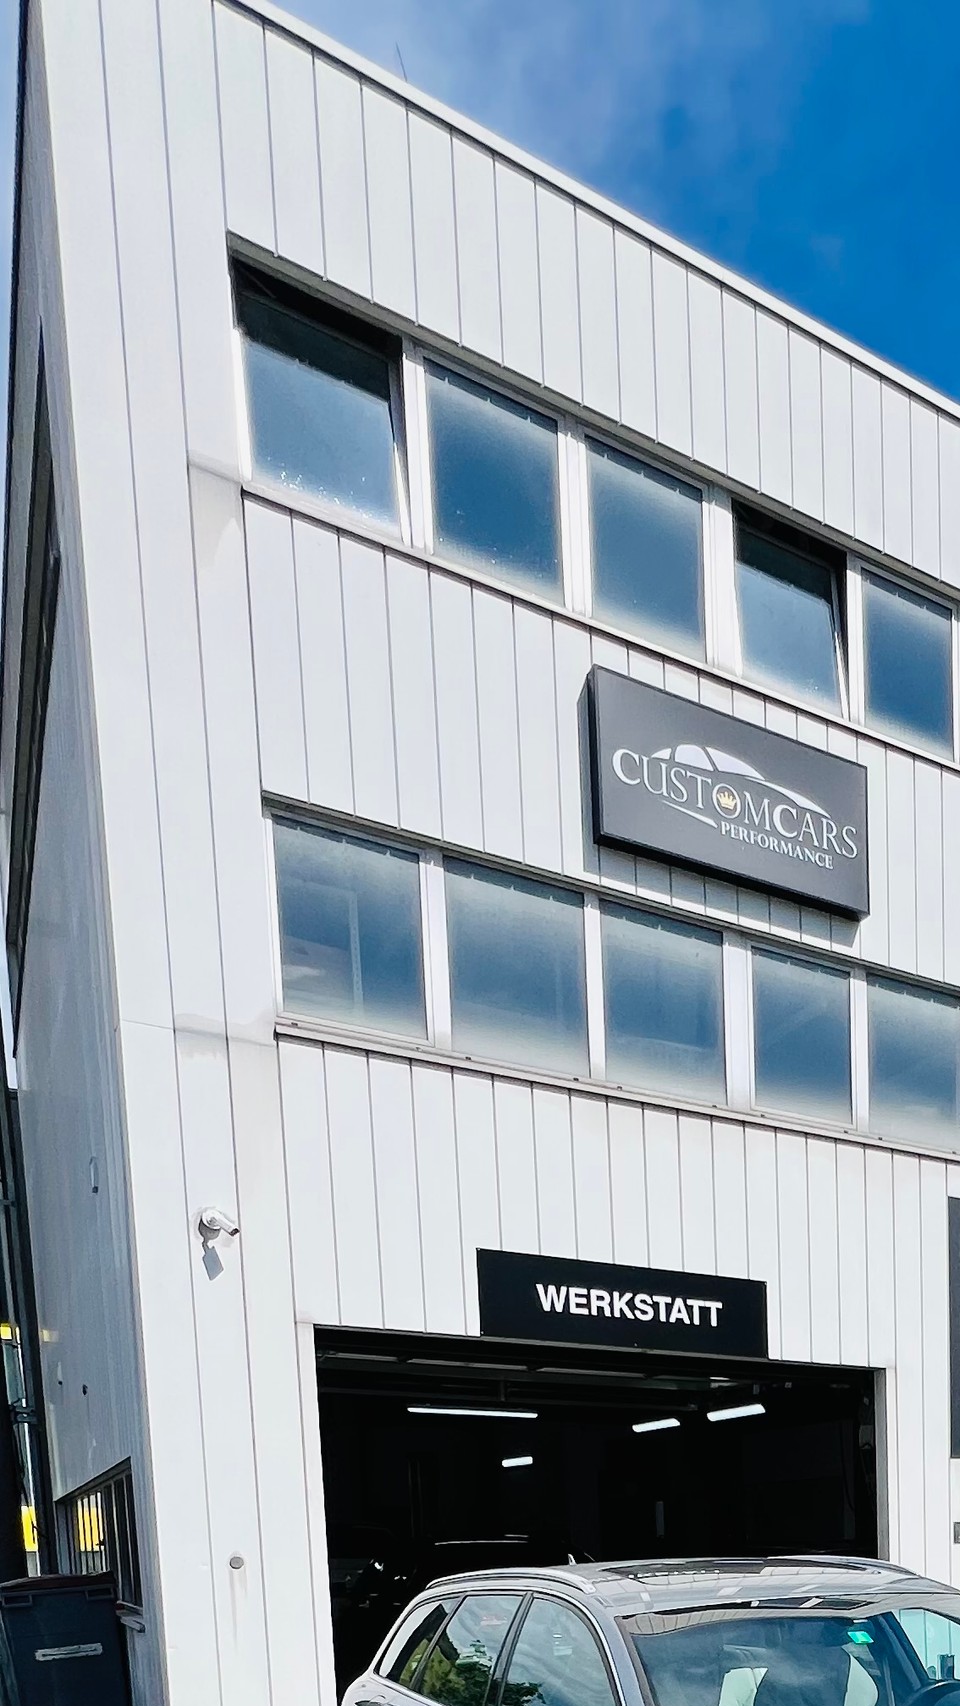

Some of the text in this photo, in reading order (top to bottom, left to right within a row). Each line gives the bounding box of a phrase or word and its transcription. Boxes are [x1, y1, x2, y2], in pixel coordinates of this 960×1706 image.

[611, 748, 858, 859] CUSTOMCARS
[721, 820, 834, 870] PERFORMANCE
[535, 1283, 723, 1327] WERKSTATT
